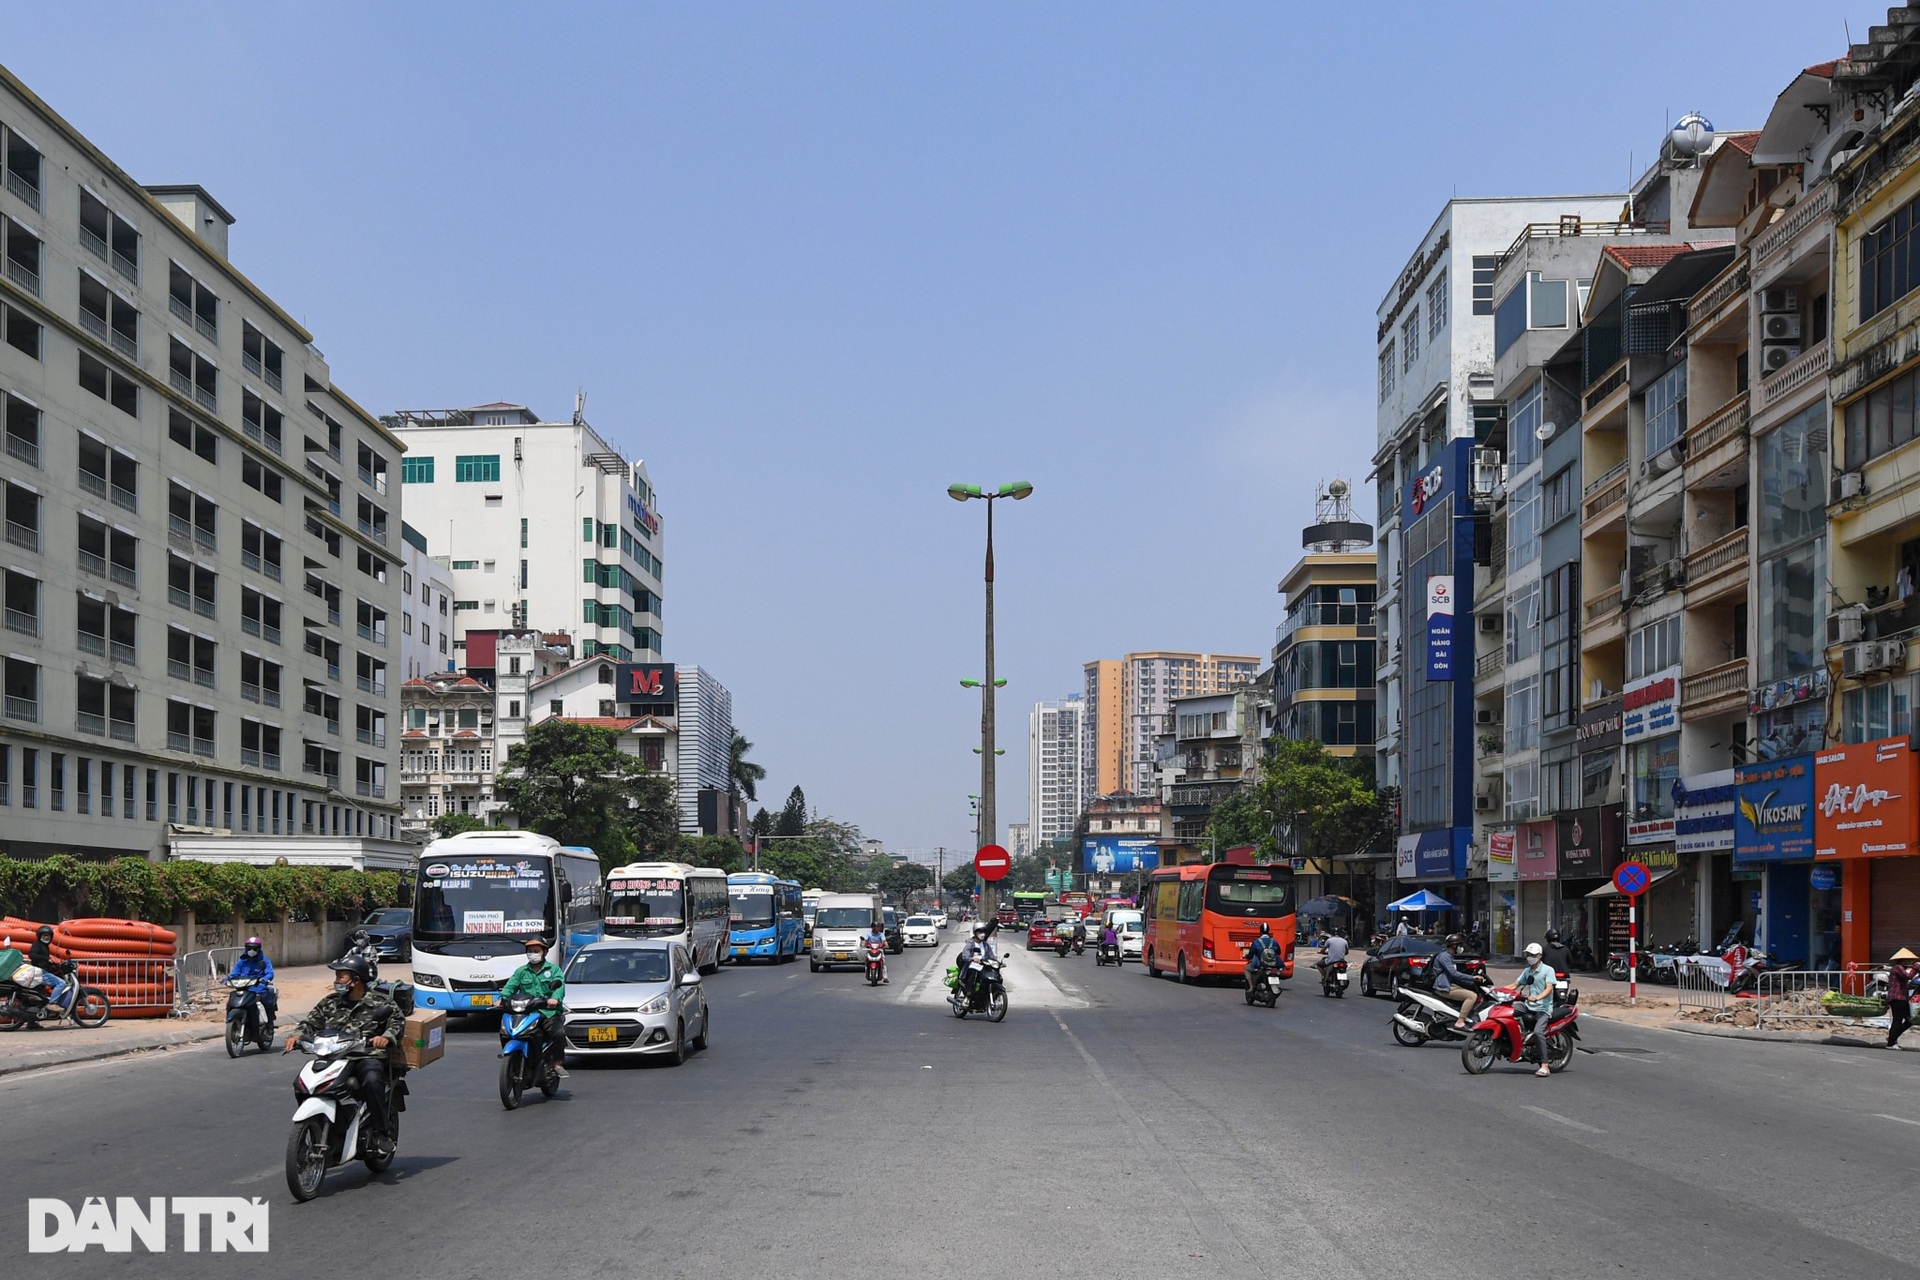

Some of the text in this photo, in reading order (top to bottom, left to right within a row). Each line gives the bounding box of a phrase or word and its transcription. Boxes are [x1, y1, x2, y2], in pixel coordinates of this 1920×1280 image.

[1422, 465, 1443, 502] SCB
[1431, 595, 1450, 604] SCB
[1431, 627, 1450, 635] NGÂN
[1431, 638, 1450, 646] HÀNG
[1435, 649, 1447, 658] SÀI
[1433, 661, 1448, 669] GÒN
[1404, 850, 1413, 863] SCB
[657, 878, 667, 890] HÀ
[667, 879, 680, 891] NỘI
[465, 920, 502, 933] NINH BÌNH
[591, 1034, 614, 1042] 614.21
